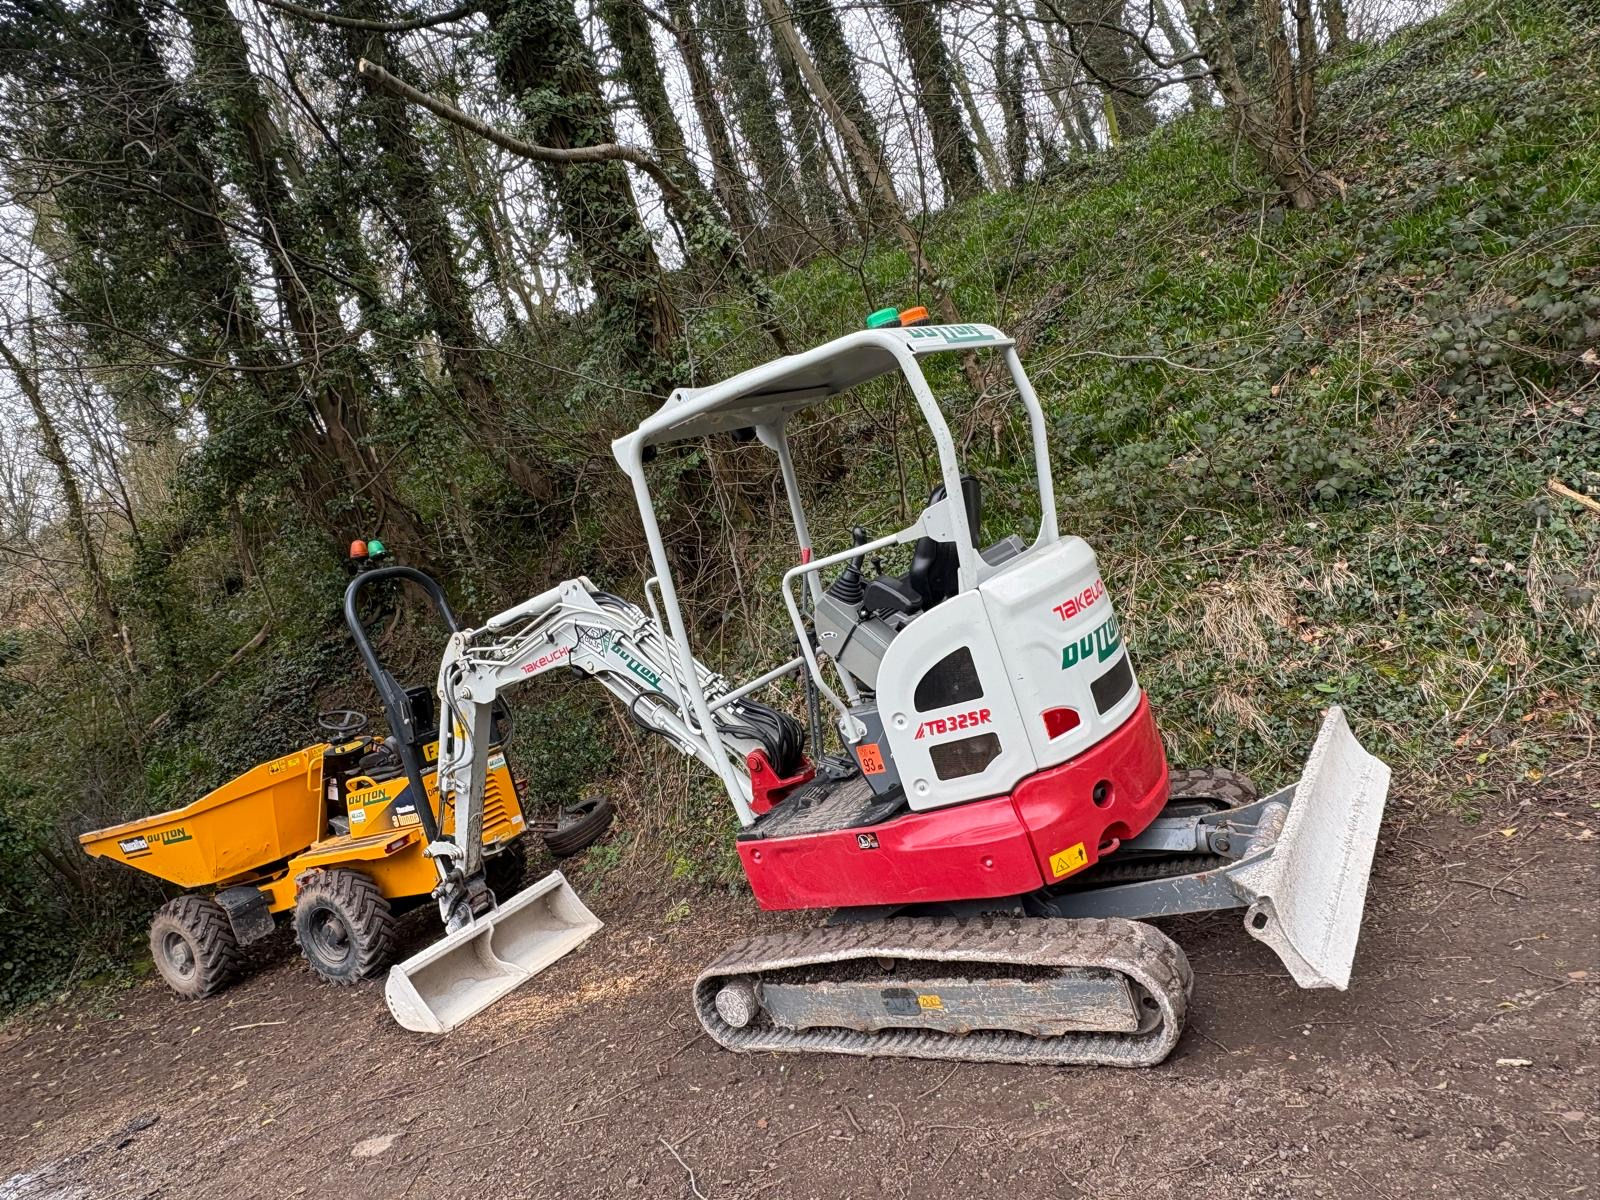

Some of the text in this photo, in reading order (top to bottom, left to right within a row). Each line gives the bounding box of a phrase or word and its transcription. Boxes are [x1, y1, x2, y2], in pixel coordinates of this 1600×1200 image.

[904, 324, 994, 344] DUTTON
[610, 643, 663, 692] DUTTON
[924, 708, 992, 735] TB325R
[863, 758, 876, 772] 93
[349, 788, 391, 806] DUTTON
[147, 828, 192, 845] DUTTON
